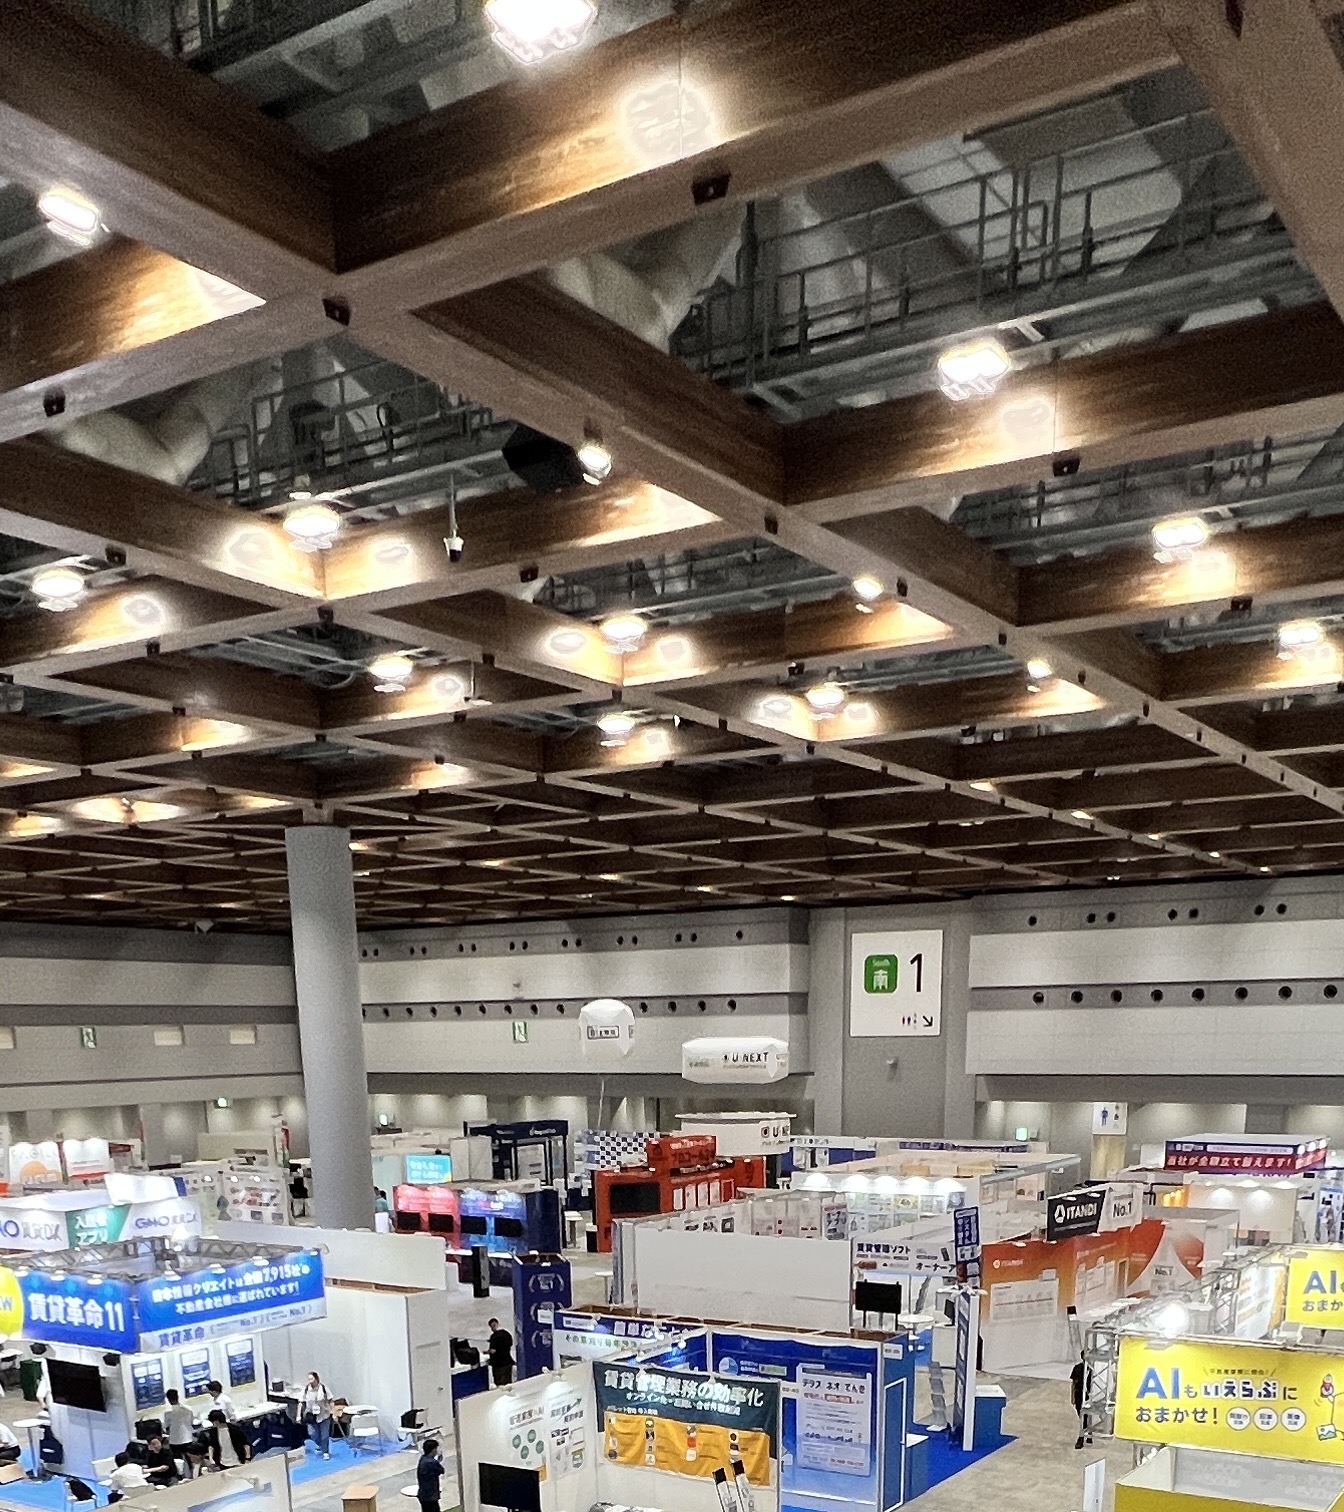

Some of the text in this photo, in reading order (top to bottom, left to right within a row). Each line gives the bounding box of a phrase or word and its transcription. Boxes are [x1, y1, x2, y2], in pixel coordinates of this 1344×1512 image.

[873, 970, 888, 990] 南
[910, 953, 922, 992] 1
[1066, 1202, 1098, 1221] ITANDI
[1112, 1201, 1133, 1218] No.1
[28, 1291, 126, 1333] 賃貸革命11
[1135, 1406, 1220, 1426] おまかせ！
